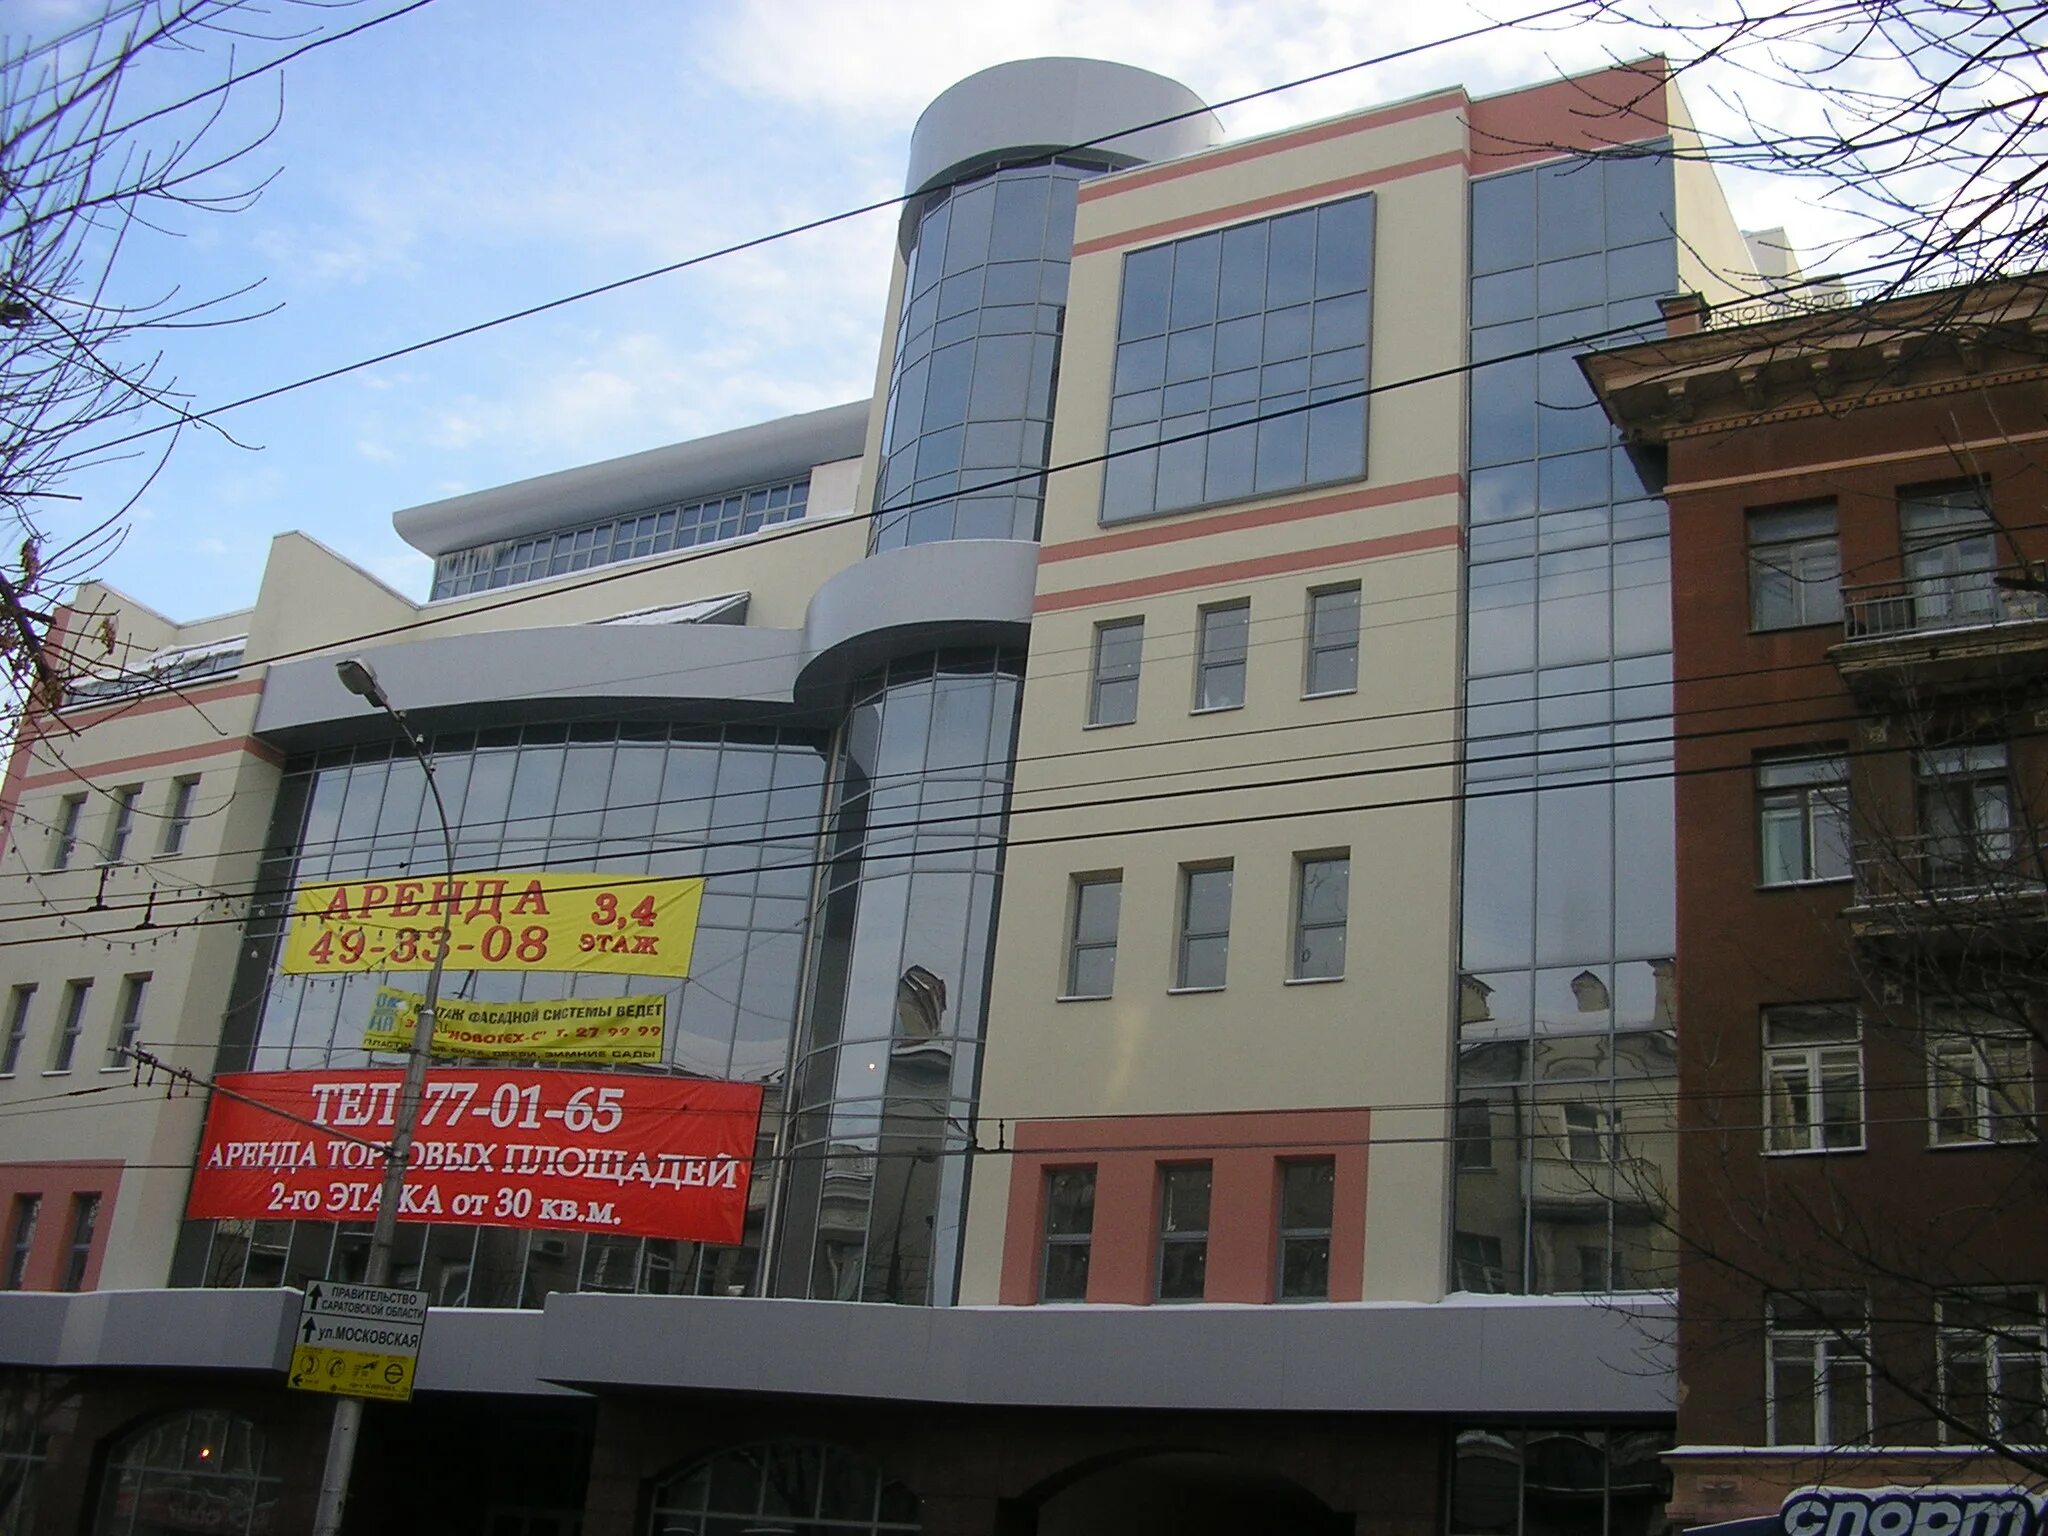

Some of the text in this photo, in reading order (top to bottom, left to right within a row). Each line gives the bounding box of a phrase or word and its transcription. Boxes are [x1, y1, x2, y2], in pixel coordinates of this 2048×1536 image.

[322, 879, 550, 924] АРЕНДА
[591, 893, 658, 931] 3,4
[308, 925, 549, 965] 49-33-08
[578, 933, 659, 955] ЭТАЖ
[469, 1007, 539, 1024] ФАСАДНОЙ
[543, 1005, 612, 1021] СИСТЕМЫ
[616, 1003, 663, 1019] ВЕДЕТ
[638, 1026, 661, 1037] 99
[612, 1050, 656, 1059] САДЫ
[421, 1082, 625, 1133] 77-01-65
[206, 1139, 741, 1190] АРЕНДА ТОРОВЫХ ПЛОЩАДЕЙ
[268, 1183, 321, 1211] 2-го
[452, 1193, 488, 1216] от
[494, 1188, 532, 1217] 30
[321, 1299, 424, 1319] САРАТОВСКОЙ ОБЛАСТИ
[331, 1286, 417, 1306] ПРАВИТЕЛЬСТВО
